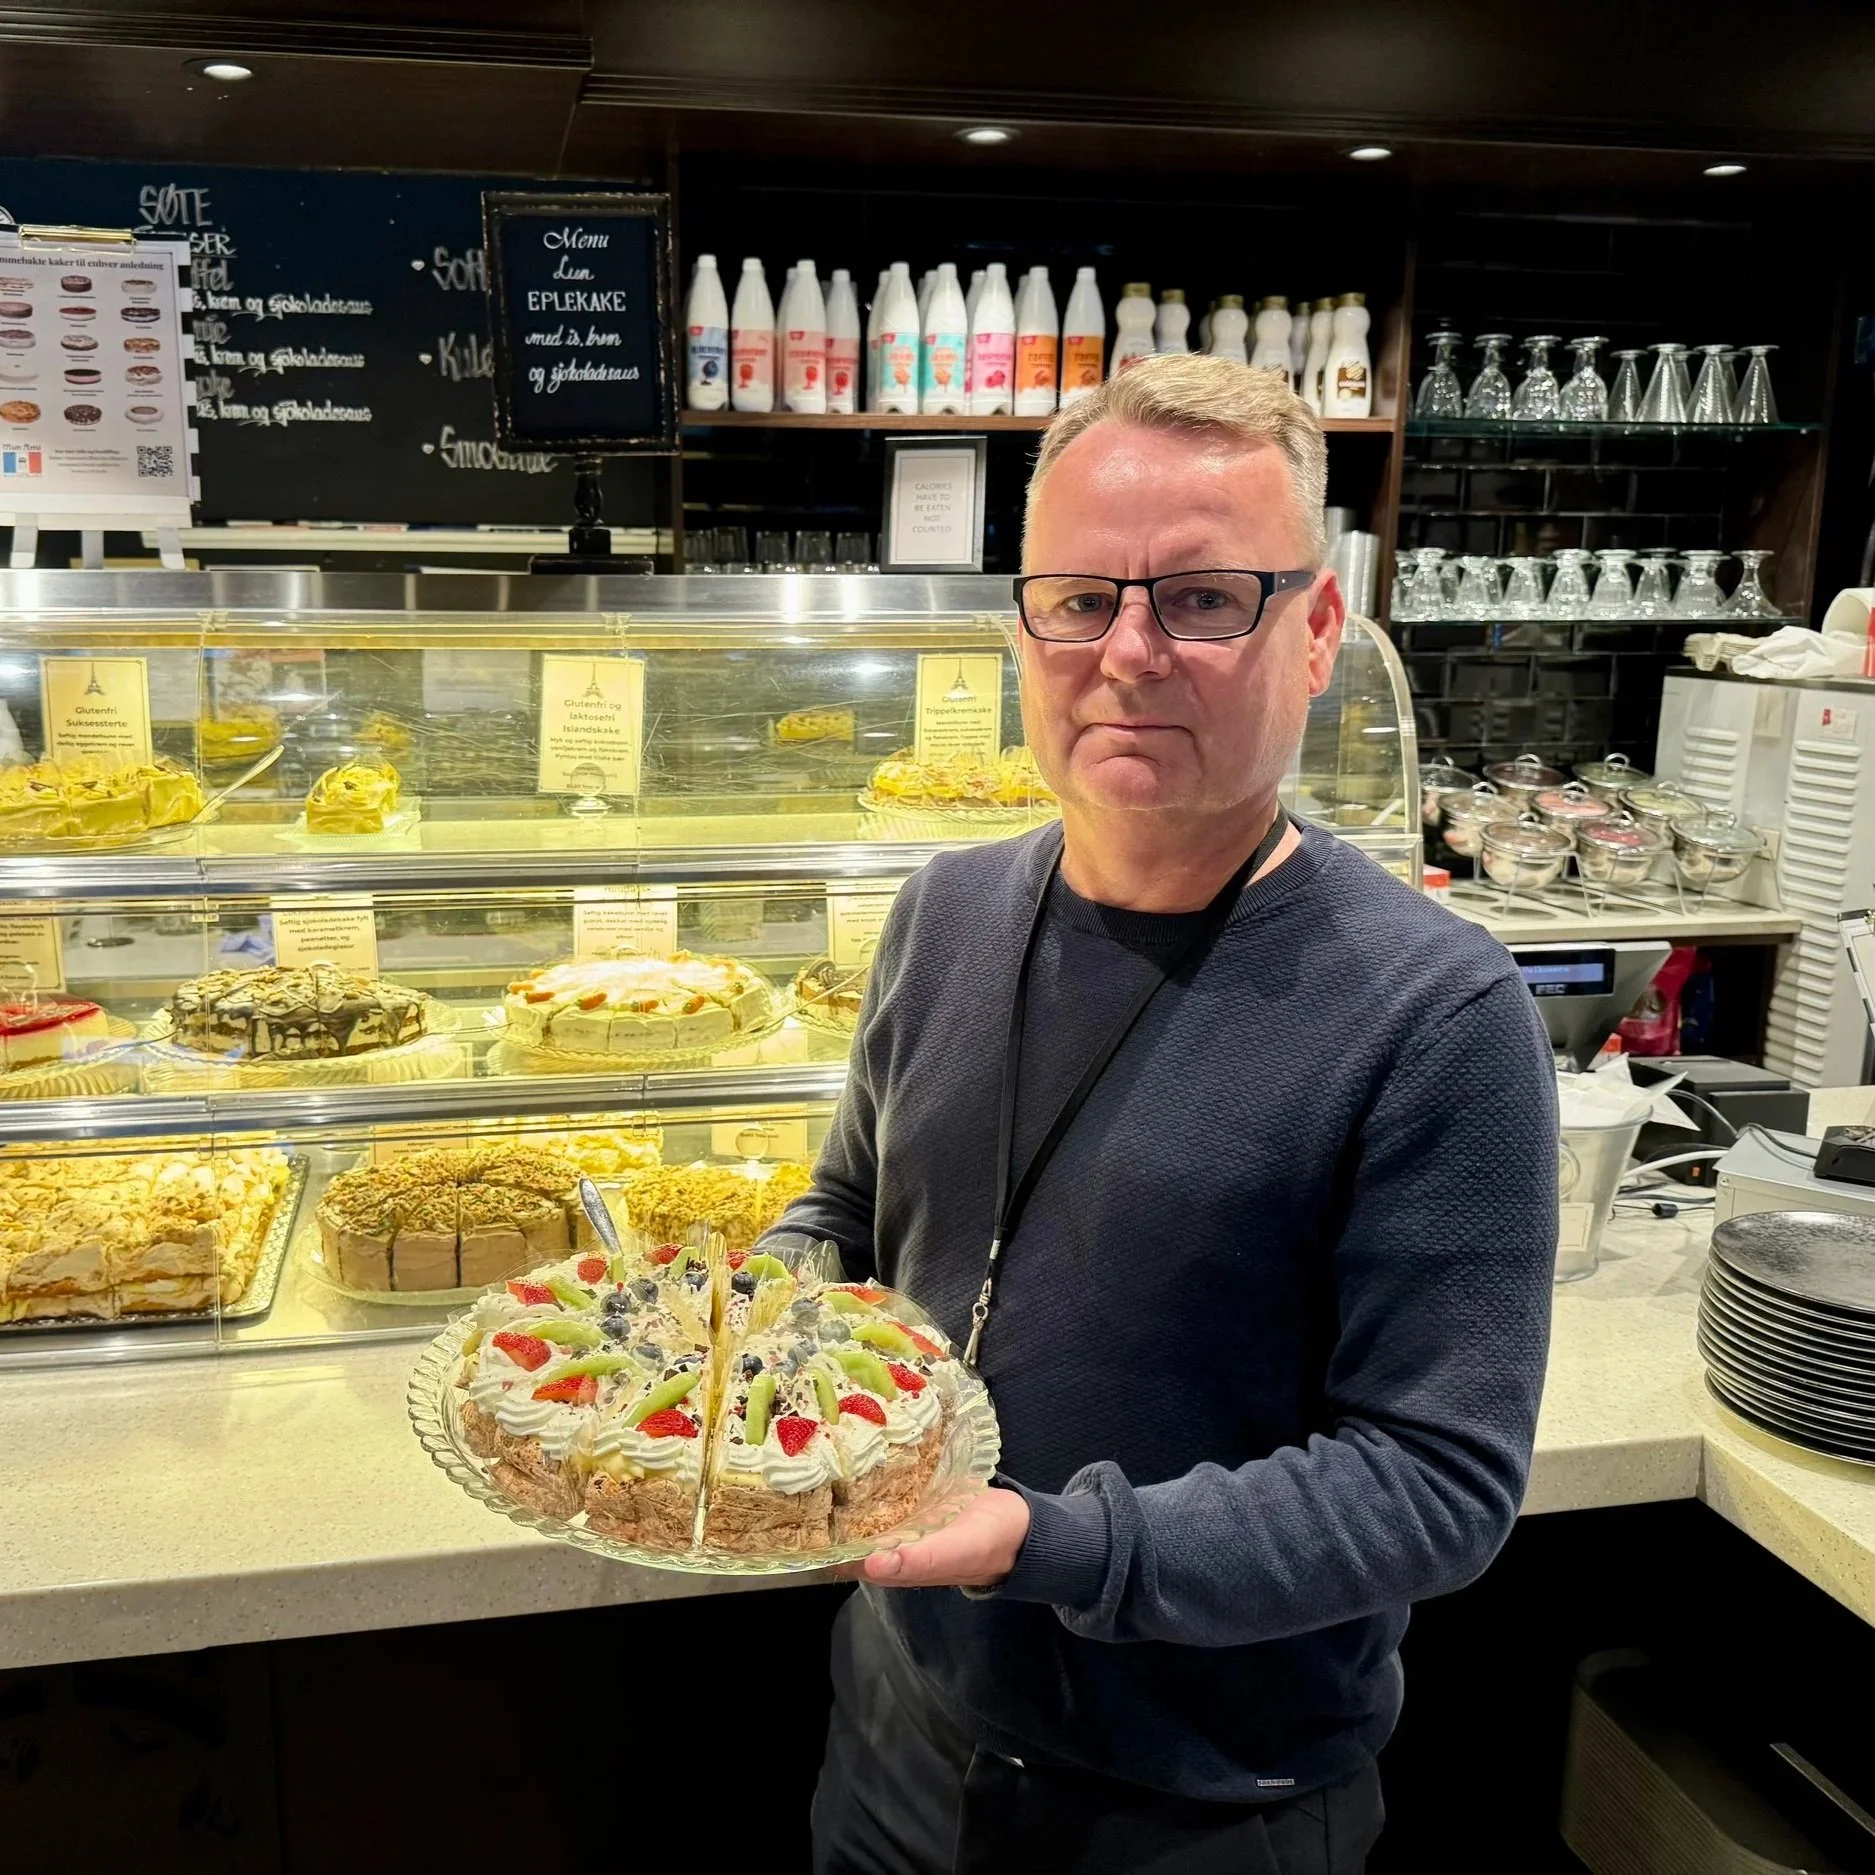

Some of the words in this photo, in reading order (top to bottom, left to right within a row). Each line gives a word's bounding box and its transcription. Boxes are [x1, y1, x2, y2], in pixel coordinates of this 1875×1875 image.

[139, 183, 213, 226] SØTE
[189, 231, 236, 255] SER
[543, 227, 609, 249] Menu
[50, 257, 74, 267] kaker
[76, 259, 85, 267] til
[88, 259, 117, 269] enhver
[120, 261, 164, 271] anledning
[553, 255, 595, 280] Lun
[206, 290, 242, 310] krem
[245, 297, 264, 320] og
[528, 291, 626, 312] EPLEKAKE
[525, 324, 563, 346] med
[585, 325, 621, 346] krem
[210, 344, 246, 365] krem
[248, 352, 266, 376] og
[528, 366, 545, 393] og
[546, 357, 640, 393] sjokoladesaus
[251, 405, 270, 425] og
[914, 482, 952, 491] CALORIES
[916, 493, 937, 501] HAVE
[939, 493, 951, 501] TO
[914, 504, 925, 512] BE
[926, 504, 951, 512] EATEN
[923, 514, 941, 522] NOT
[912, 525, 952, 534] COUNTED
[75, 706, 117, 715] Glutenfri
[564, 699, 607, 709] Glutenfri
[609, 703, 621, 711] og
[925, 707, 992, 715] Trippelkremkake
[66, 719, 128, 728] Suksessterte
[569, 712, 615, 722] laktosefri
[563, 725, 621, 735] Islandskake
